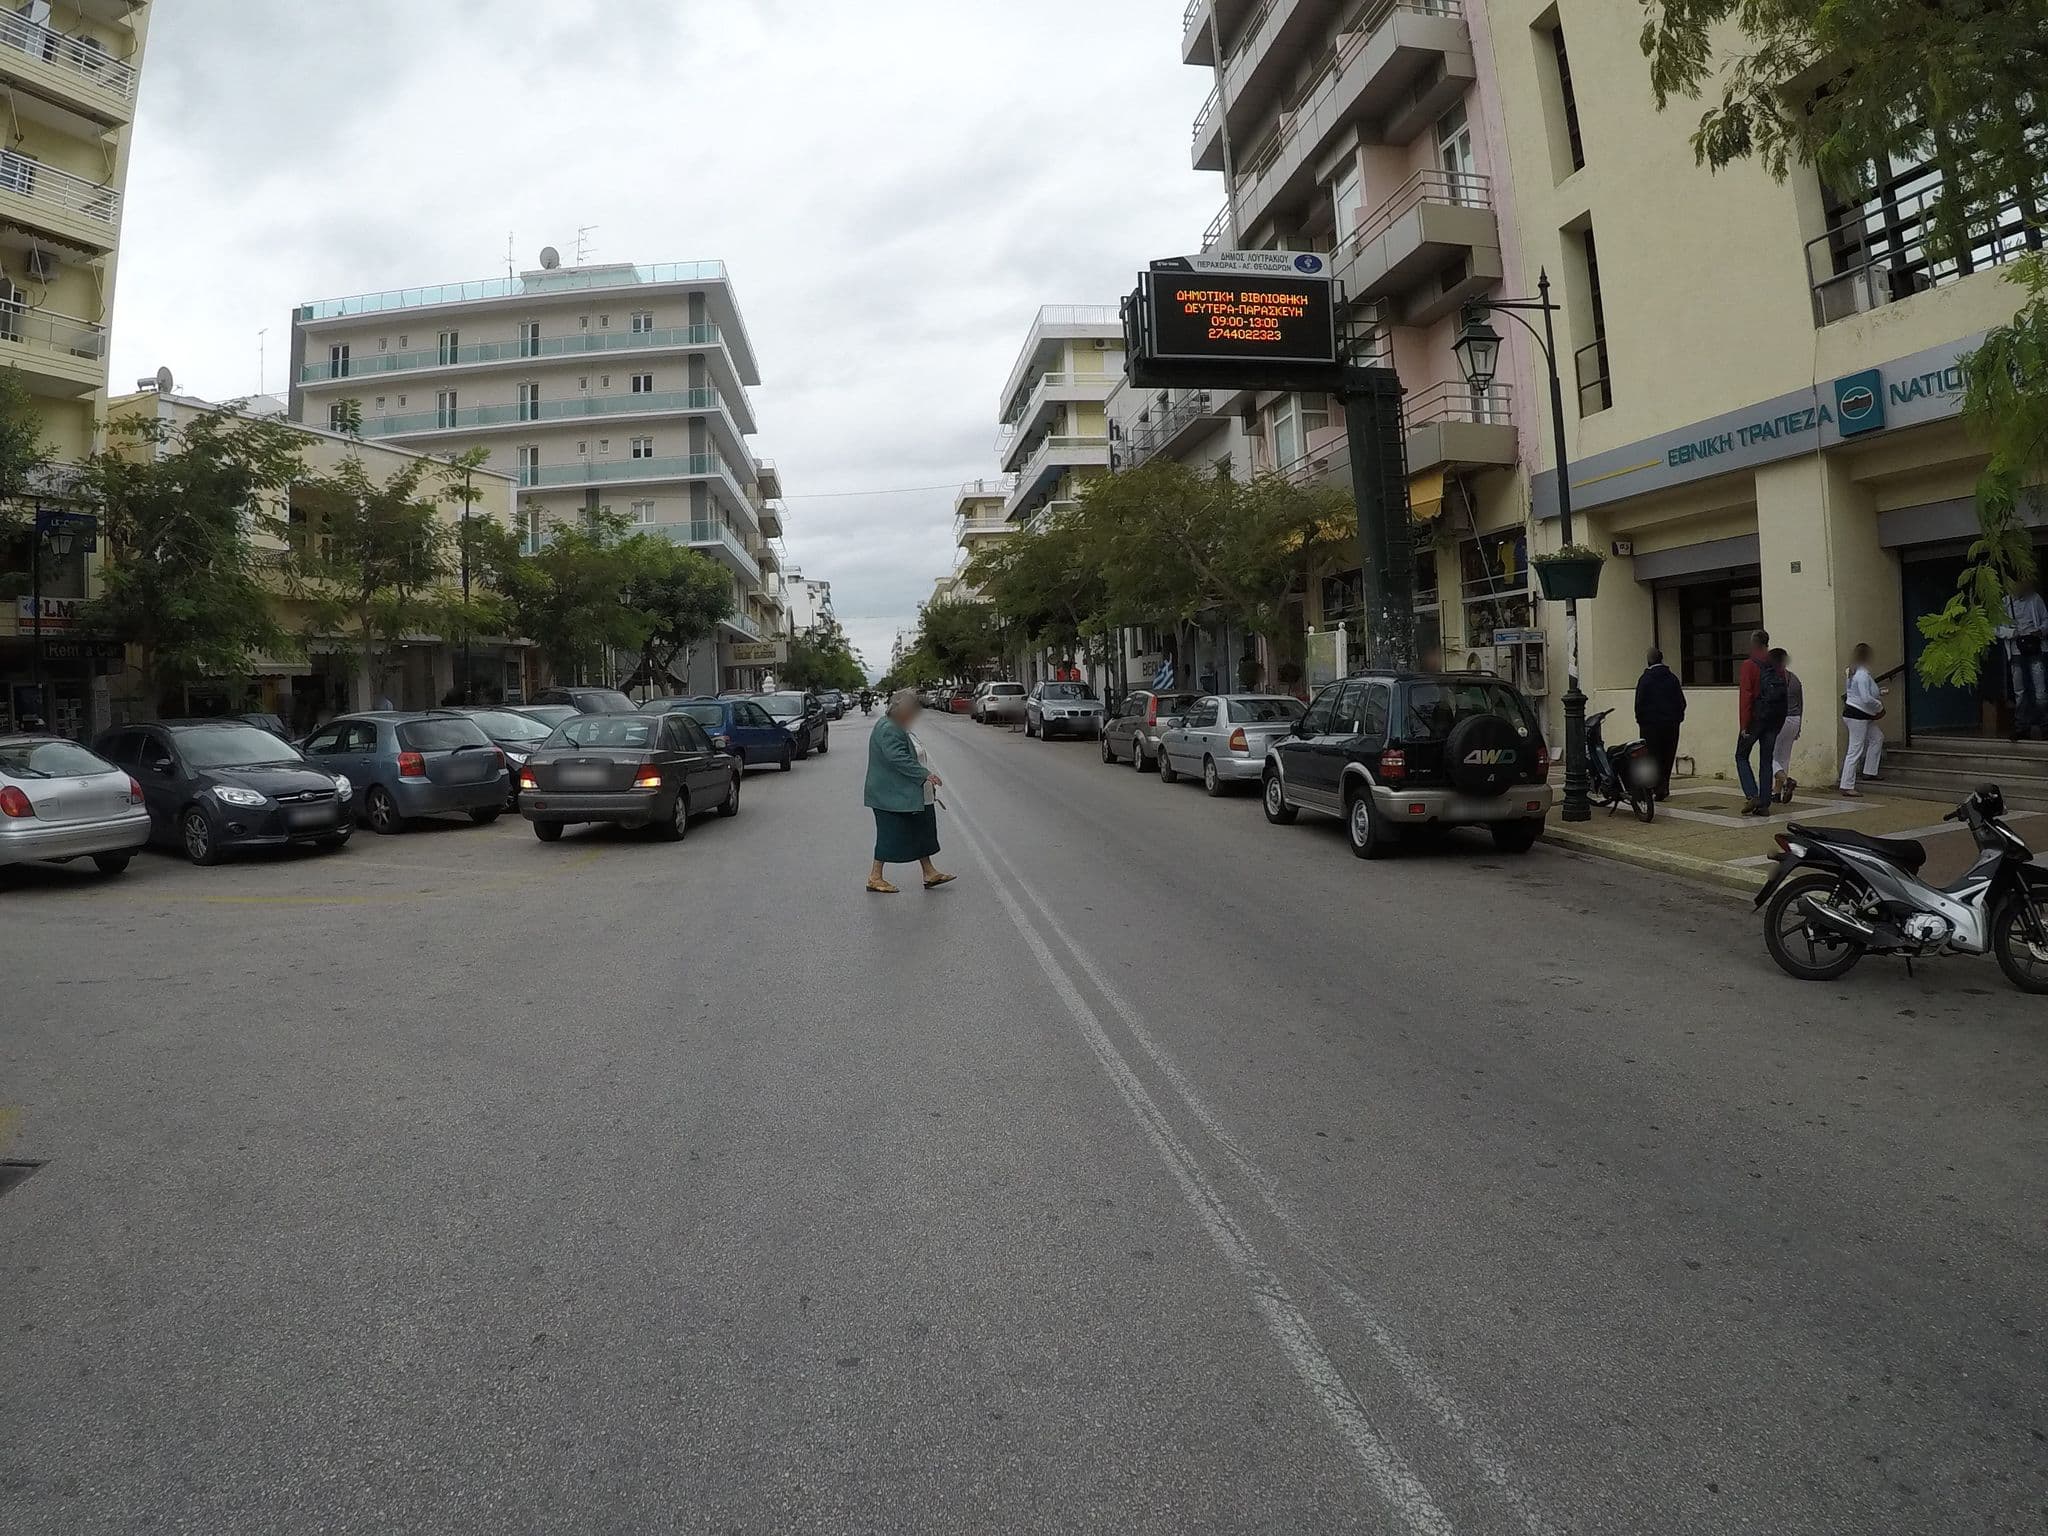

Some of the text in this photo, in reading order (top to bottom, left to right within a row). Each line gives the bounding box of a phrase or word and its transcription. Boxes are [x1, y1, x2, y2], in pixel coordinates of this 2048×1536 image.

[1220, 252, 1288, 263] ΔΗΜΟΣ ΛΟΥΤΡΑΚΙΟΥ
[1197, 260, 1237, 270] ΠΕΡΑΧΩΡΑΣ
[1253, 262, 1292, 272] ΘΕΟΔΩΡΩΝ
[1176, 290, 1308, 305] ΔΗΜΟΤΙΚΗ ΒΙΒΛΙΟΘΗΚΗ
[1184, 303, 1303, 317] ΔΕΥΤΕΡΑ-ΠΑΡΑΣΚΕΥΗ
[1211, 316, 1278, 328] 09:00-13:00
[1208, 328, 1281, 341] 2744022323
[1668, 404, 1834, 467] ΕΘΝΙΚΗ ΤΡΑΠΕΖΑ
